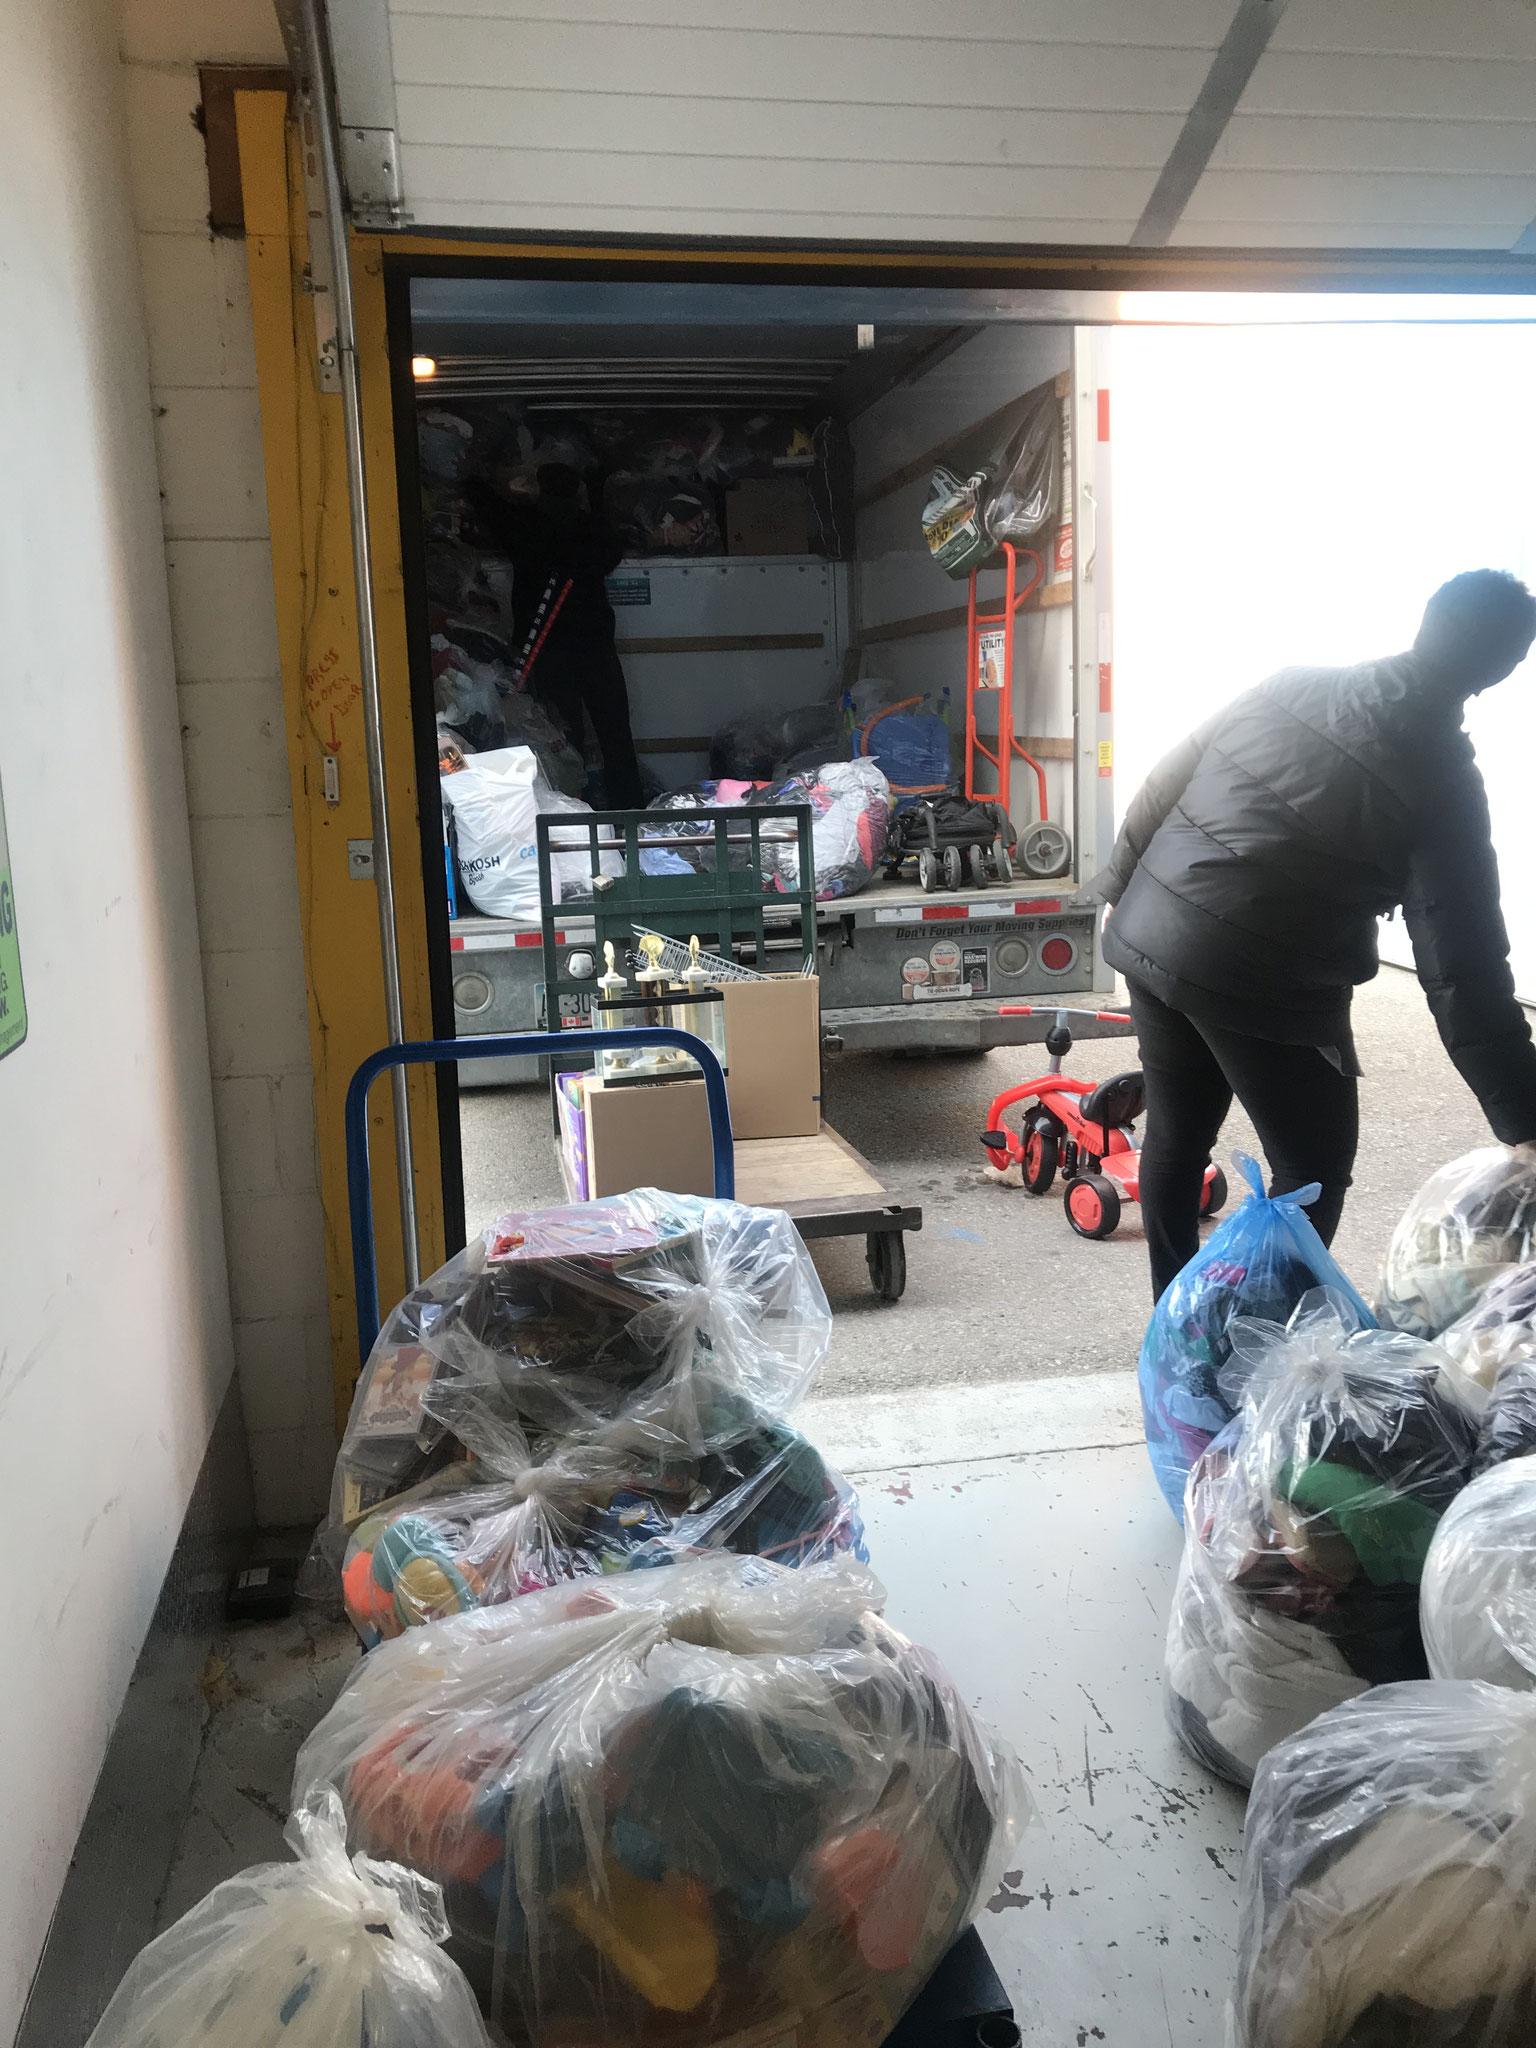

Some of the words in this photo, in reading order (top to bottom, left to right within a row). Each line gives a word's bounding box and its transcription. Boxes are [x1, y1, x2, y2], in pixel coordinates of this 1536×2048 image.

[896, 927, 926, 938] Don't
[929, 925, 965, 937] Forget
[968, 922, 991, 934] Your
[995, 919, 1035, 931] Moving
